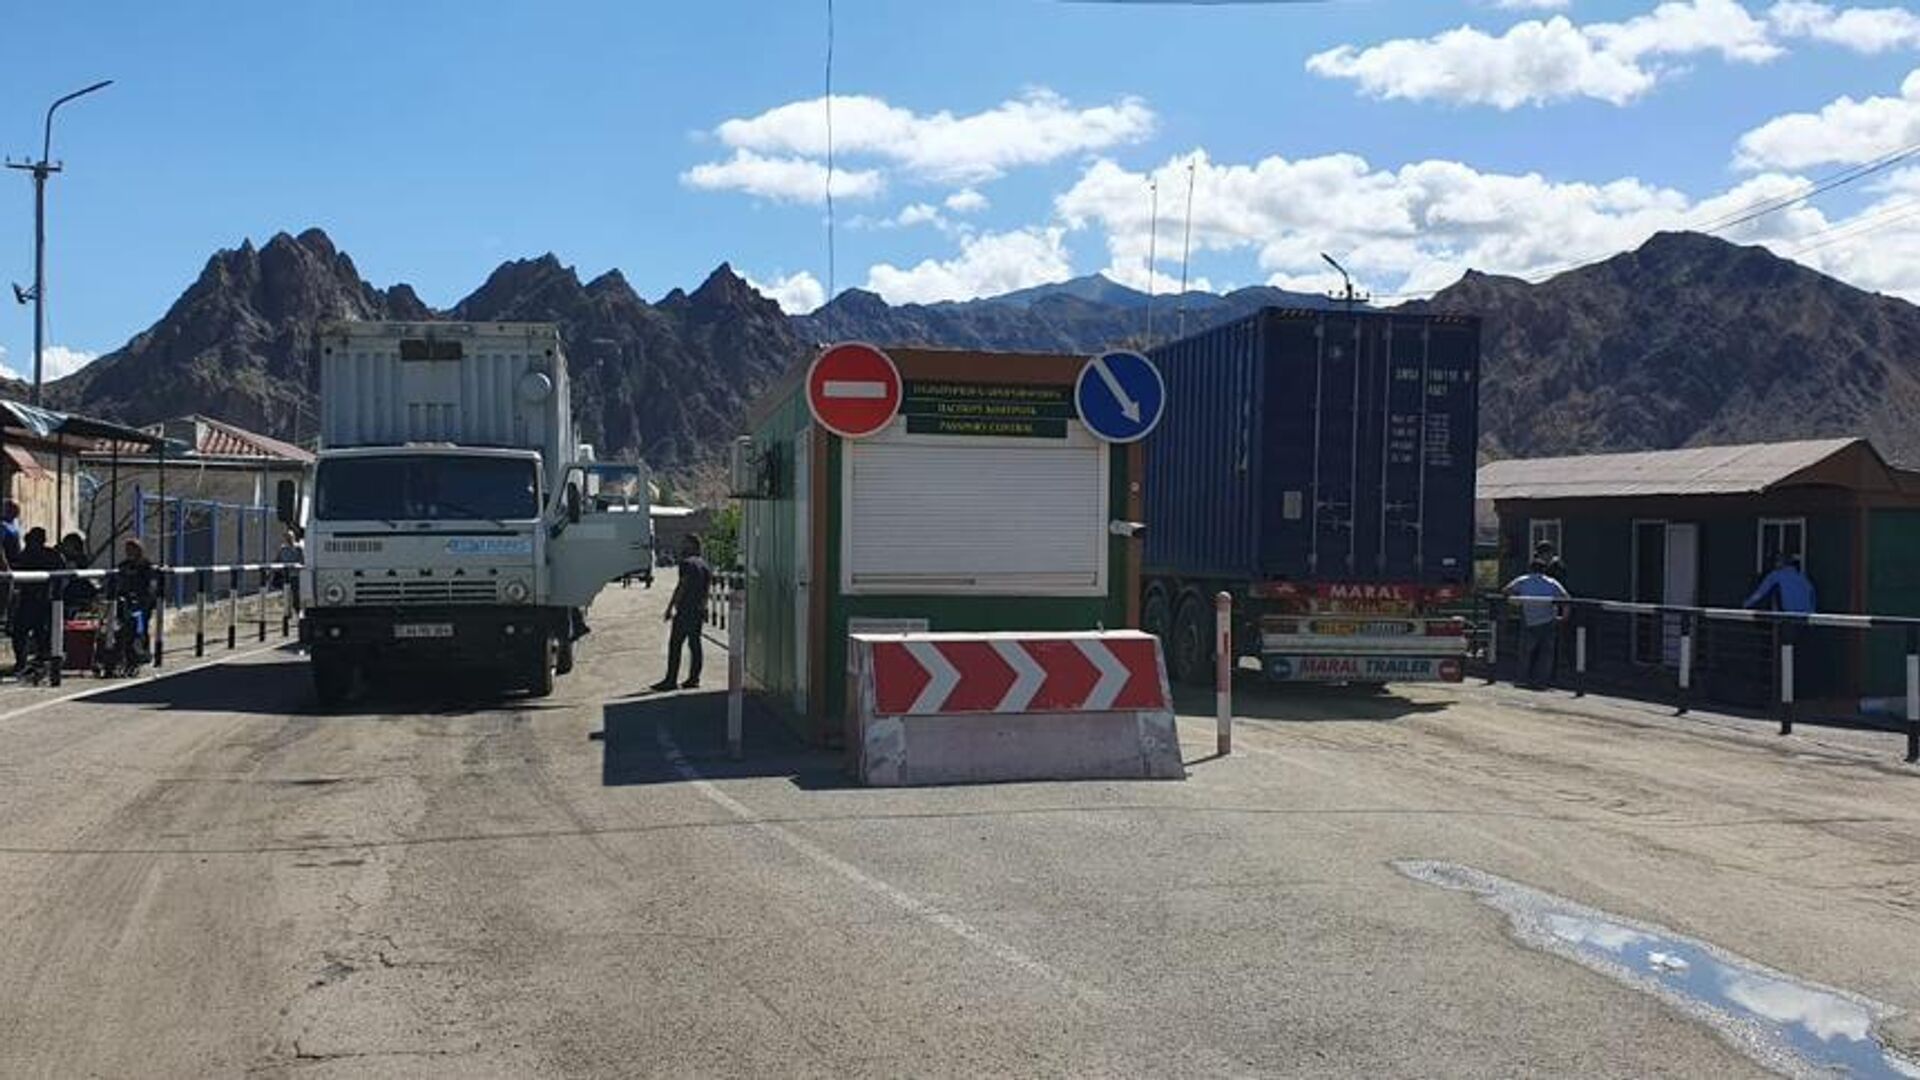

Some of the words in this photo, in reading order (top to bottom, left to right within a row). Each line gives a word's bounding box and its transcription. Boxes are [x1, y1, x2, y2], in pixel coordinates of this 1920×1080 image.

[1328, 584, 1401, 600] MARAL
[1301, 658, 1360, 674] MARAL
[1365, 659, 1432, 675] TRAILER
